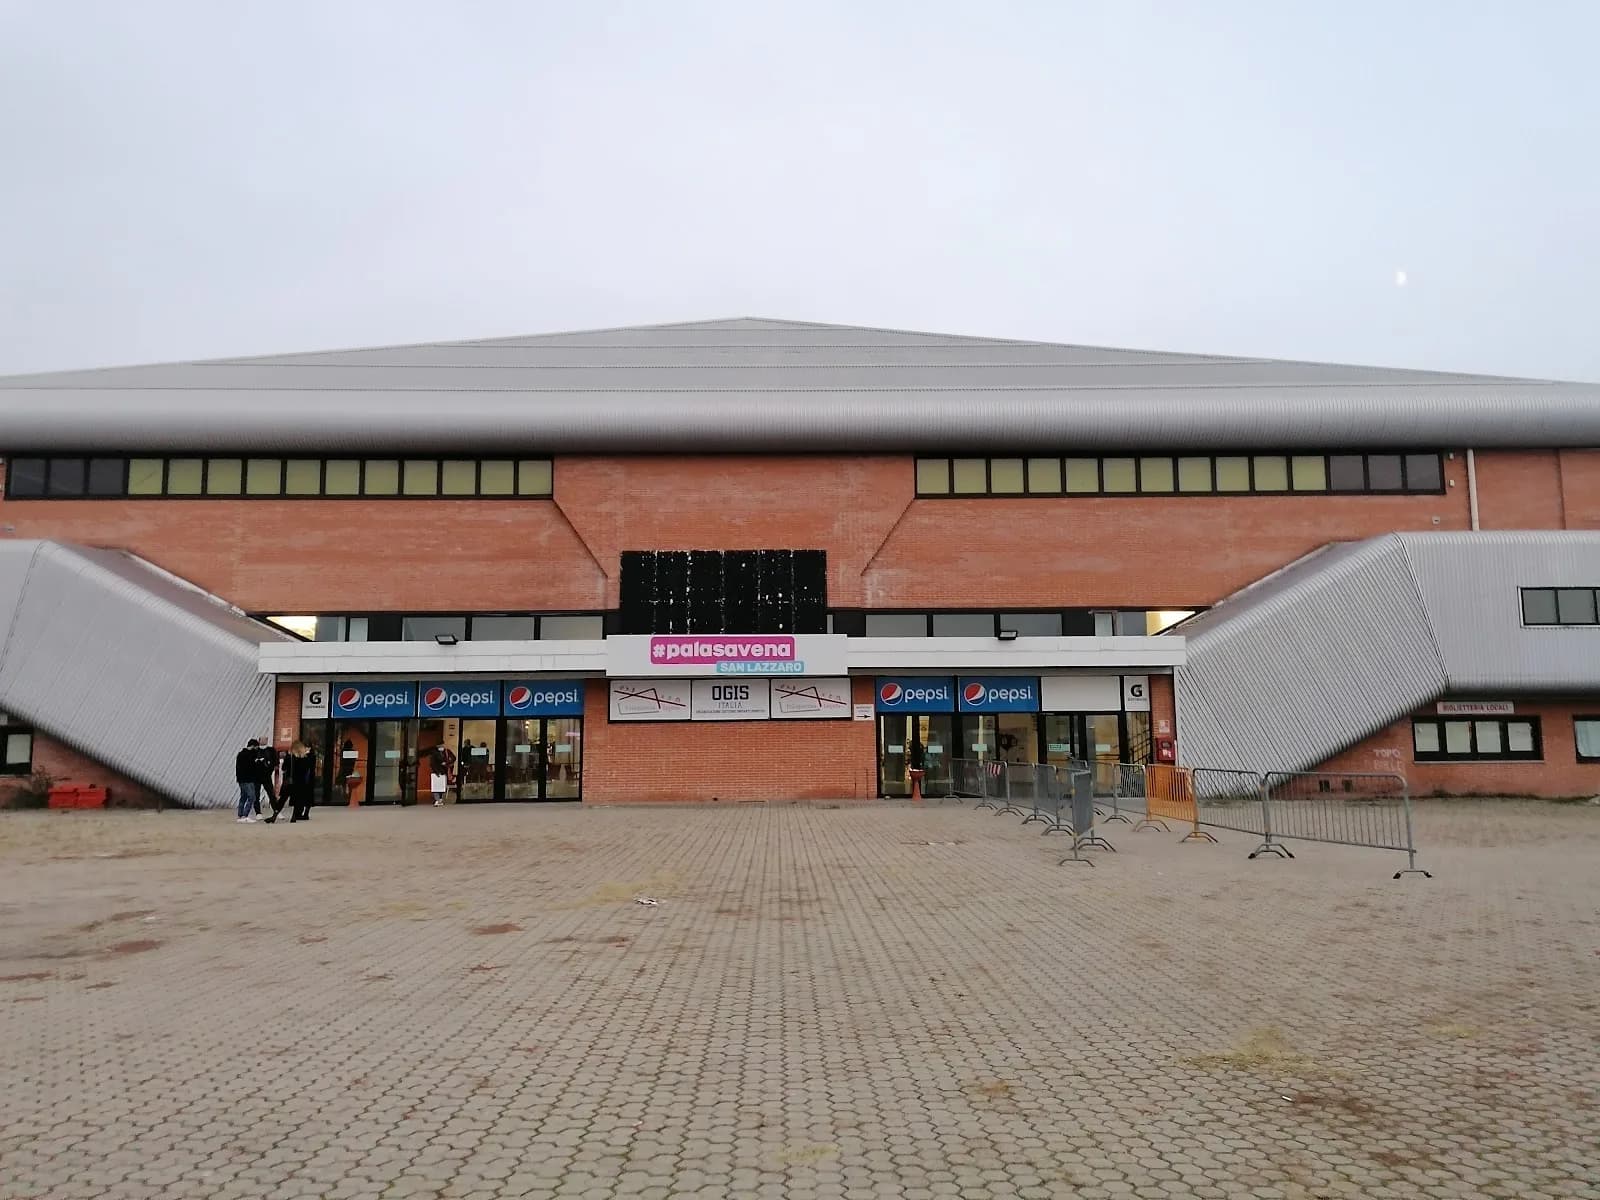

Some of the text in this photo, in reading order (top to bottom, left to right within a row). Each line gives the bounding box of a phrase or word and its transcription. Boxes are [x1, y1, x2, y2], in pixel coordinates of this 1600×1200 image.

[652, 641, 791, 660] #palasavena
[720, 662, 802, 673] SAN LAZZARO
[310, 691, 321, 704] G
[449, 690, 493, 708] pepsi
[534, 689, 578, 707] pepsi
[712, 685, 749, 700] OGIS
[904, 686, 948, 703] pepsi
[988, 686, 1032, 703] pepsi
[1131, 684, 1142, 697] G
[363, 691, 409, 709] pepsi
